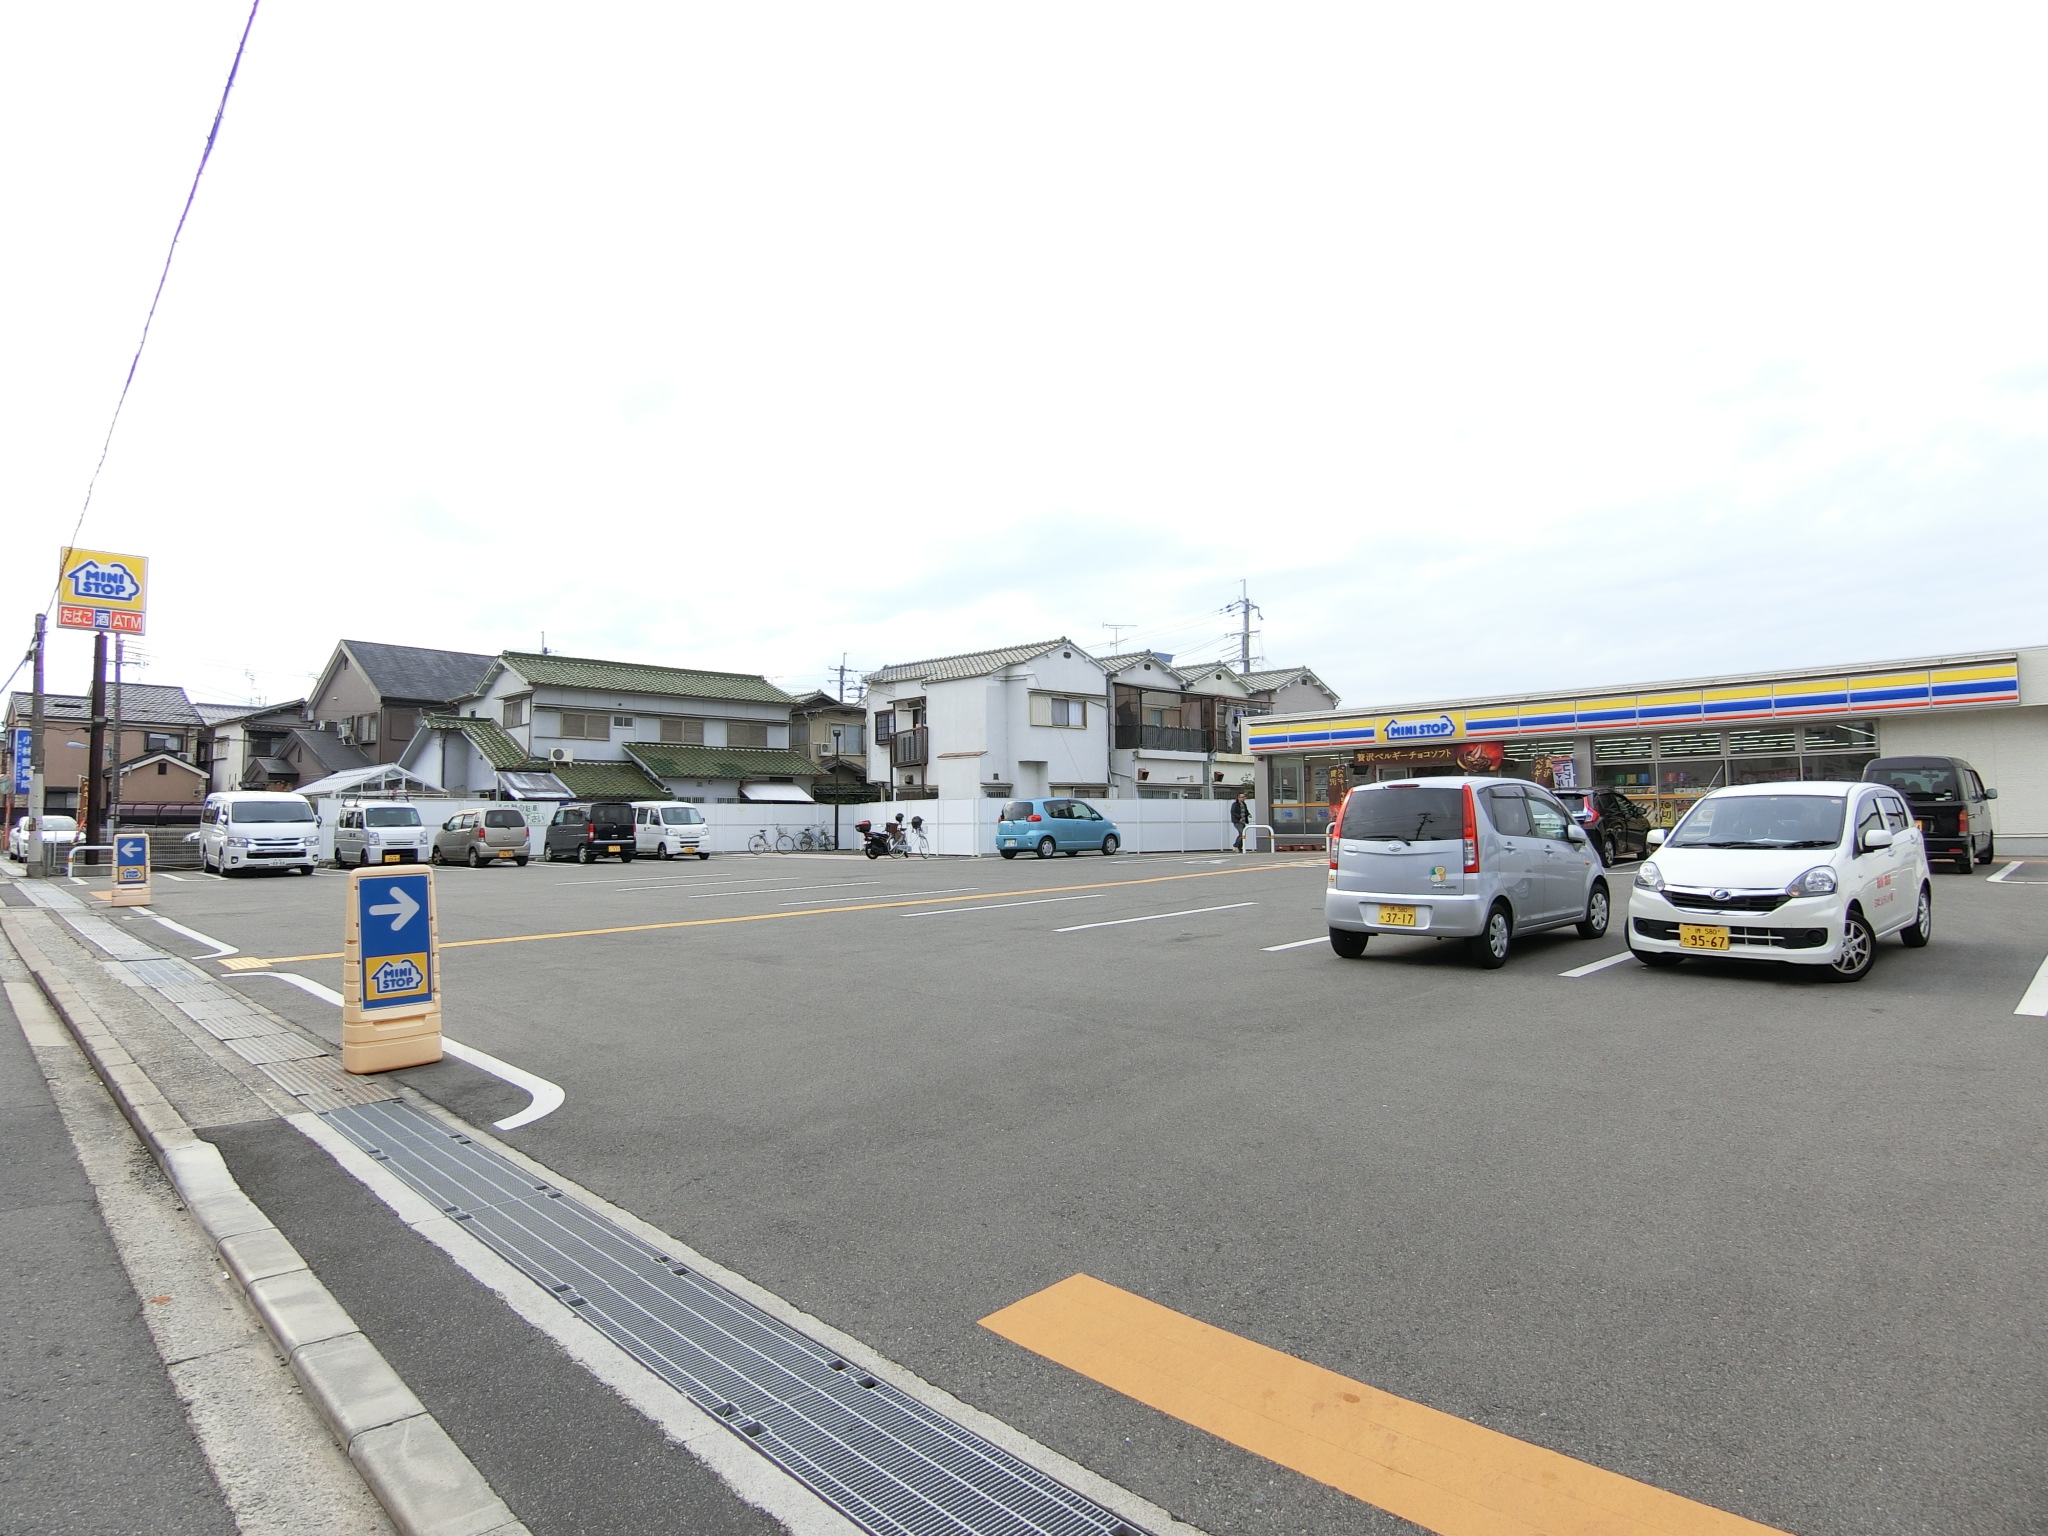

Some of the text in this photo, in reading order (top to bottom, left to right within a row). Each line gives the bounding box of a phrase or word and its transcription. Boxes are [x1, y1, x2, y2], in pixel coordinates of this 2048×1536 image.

[85, 570, 124, 584] MINI
[82, 581, 126, 595] STOP
[62, 609, 142, 629] たばこ 酒 ATM
[1390, 722, 1449, 736] MINI STOP
[1356, 748, 1452, 762] 贅沢ベルギーチョコソフト
[1386, 913, 1413, 924] 37-17
[1691, 935, 1725, 947] 95-67
[383, 968, 412, 979] MINI
[383, 977, 414, 989] STOP
